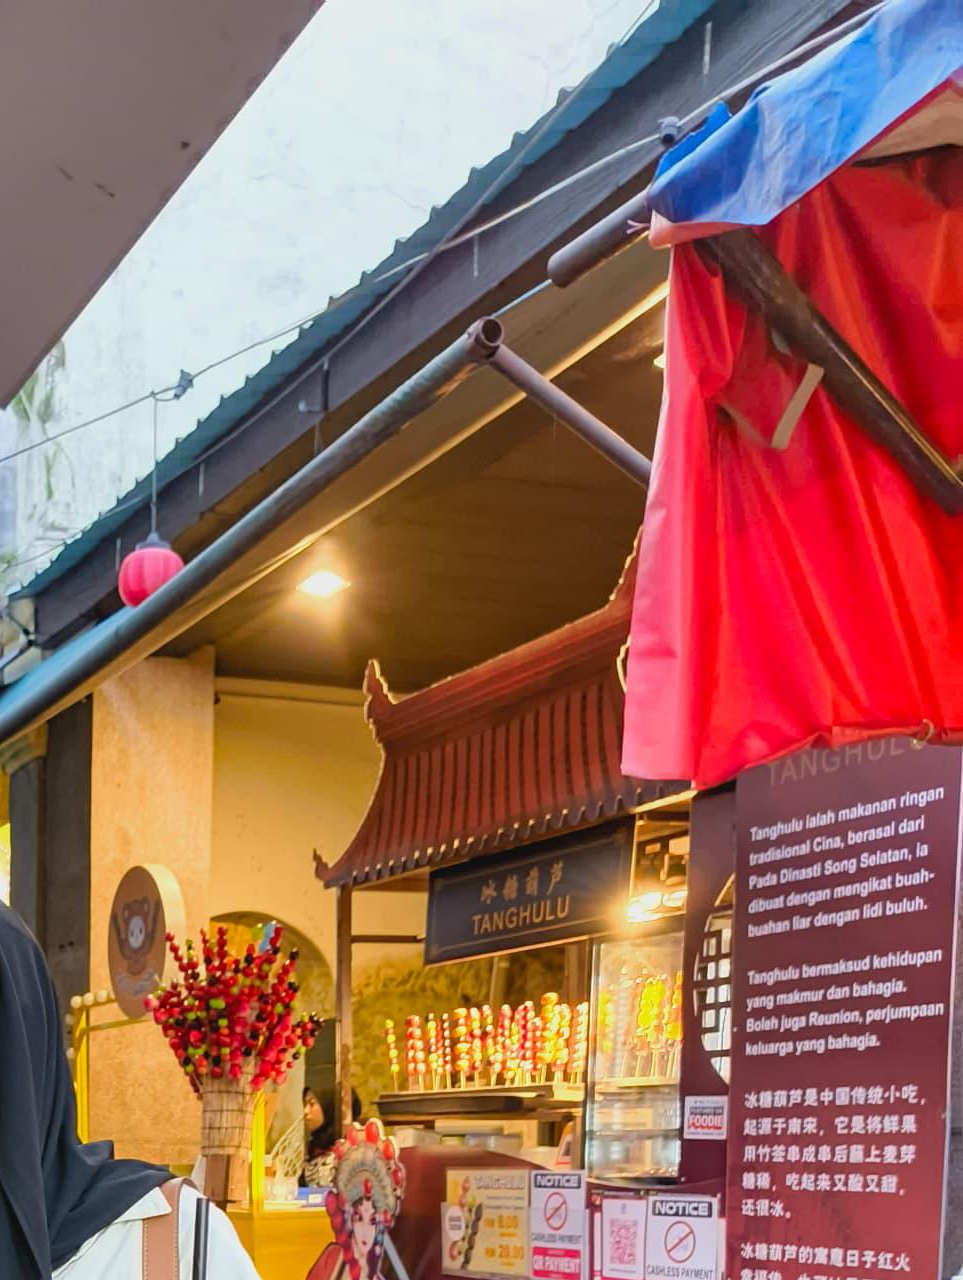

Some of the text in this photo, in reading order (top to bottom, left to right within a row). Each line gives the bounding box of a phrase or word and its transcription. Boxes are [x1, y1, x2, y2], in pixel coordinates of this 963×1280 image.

[768, 738, 905, 785] TANGHUL
[750, 787, 944, 841] Tanghulu ialah makanan ringan
[749, 815, 925, 866] tradisional Cina, berasal dari
[748, 842, 928, 890] Pada Dinasti Song Selatan, ia
[748, 868, 935, 914] dibuat dengan mengikat buah-
[472, 895, 570, 935] TANGHULU
[748, 896, 928, 938] buahan liar dengan lidi buluh.
[748, 949, 942, 986] Tanghulu bermaksud kehidupan
[746, 978, 907, 1012] yang makmur dan bahagia.
[746, 1003, 944, 1033] Boleh juga Reunion, perjumpaan
[745, 1031, 881, 1057] keluarga yang bahagia.
[536, 1175, 578, 1187] NOTICE
[654, 1201, 710, 1216] NOTICE
[647, 1264, 714, 1280] CASHLESS PAYMENT
